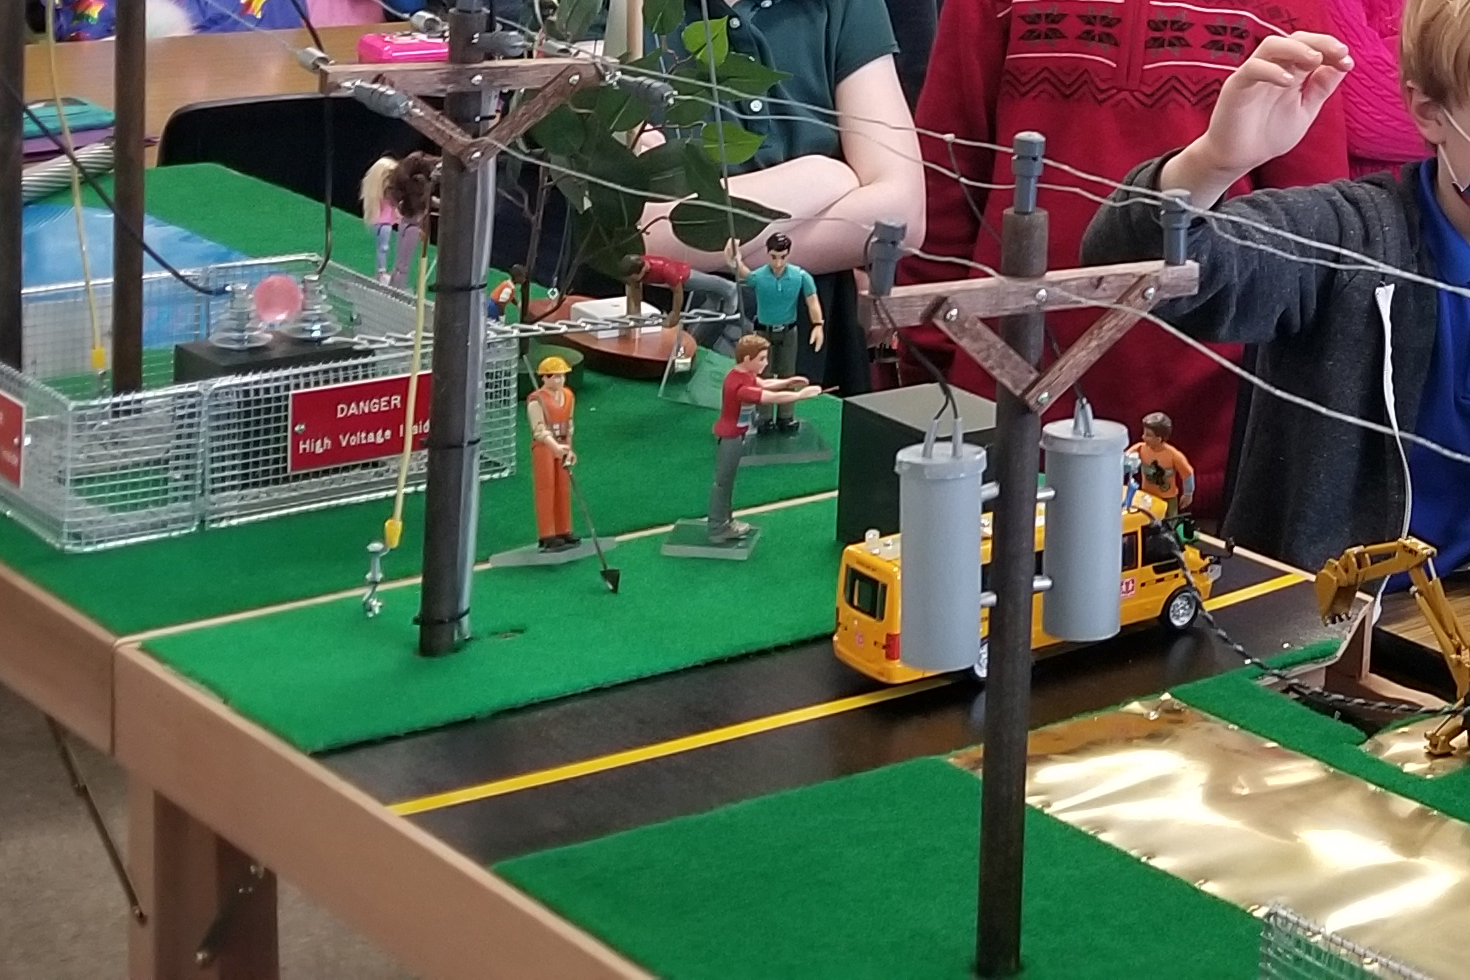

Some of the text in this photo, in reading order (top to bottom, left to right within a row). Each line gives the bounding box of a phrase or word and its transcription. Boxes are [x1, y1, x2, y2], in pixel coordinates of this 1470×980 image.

[336, 395, 402, 419] DANGER
[299, 436, 332, 454] High
[339, 427, 392, 448] Voltage
